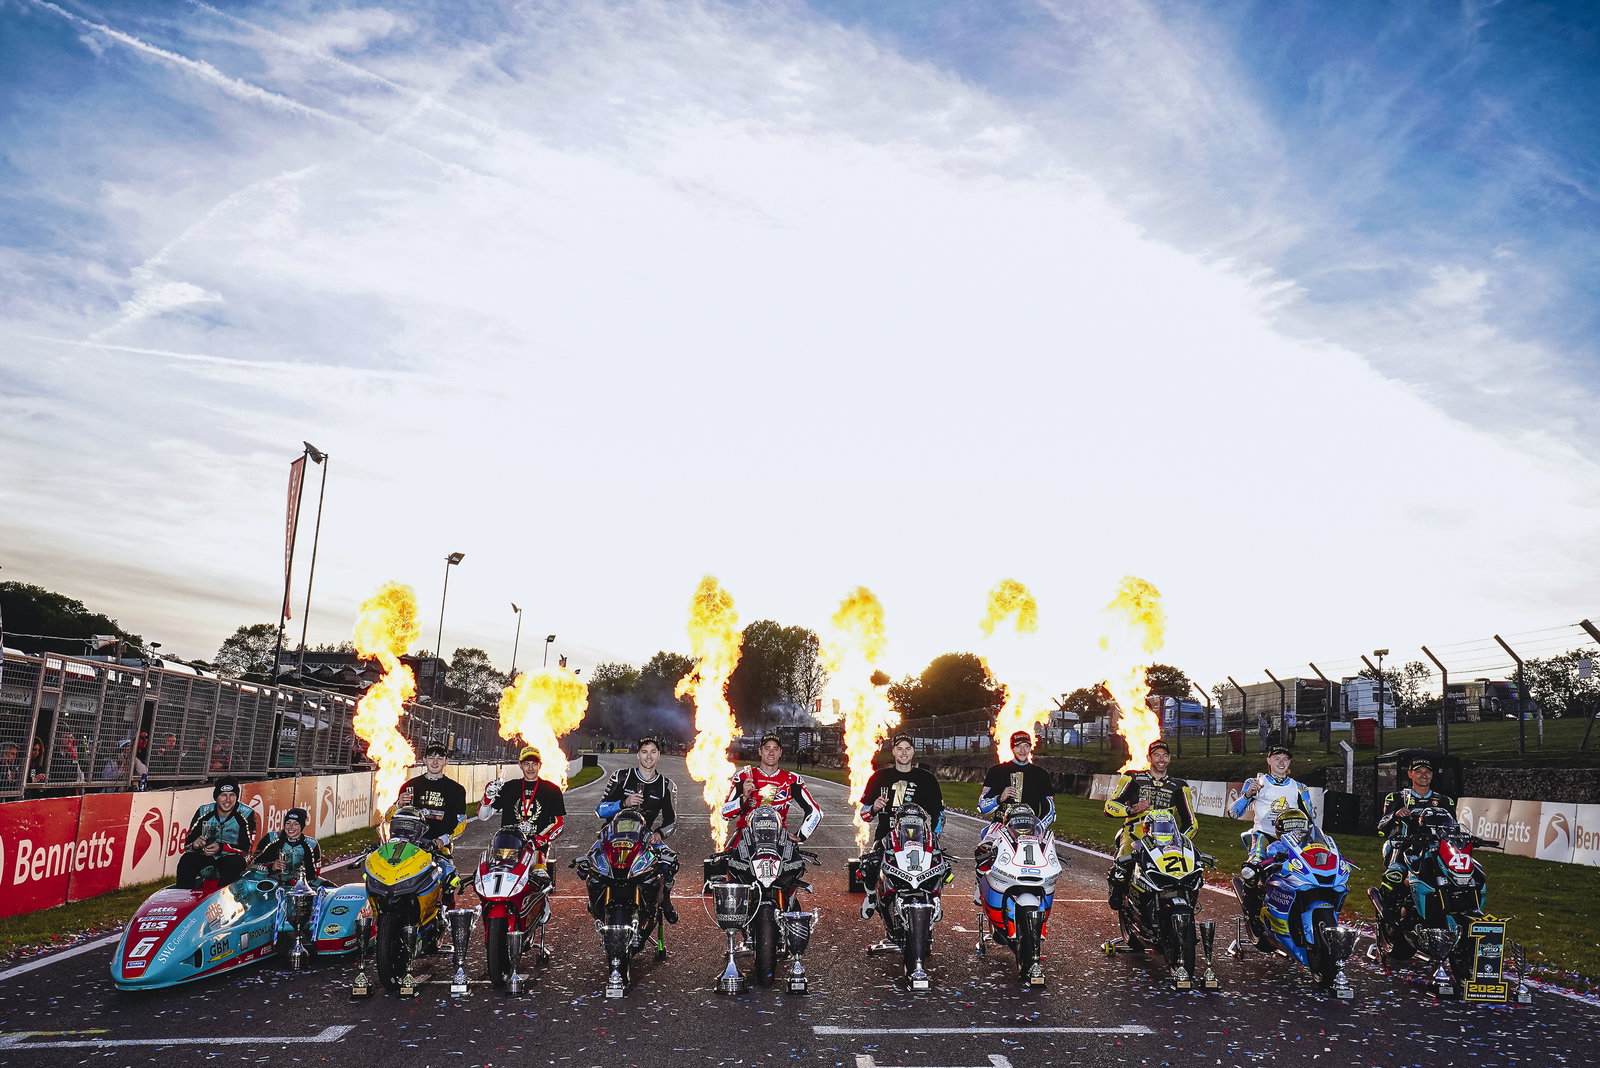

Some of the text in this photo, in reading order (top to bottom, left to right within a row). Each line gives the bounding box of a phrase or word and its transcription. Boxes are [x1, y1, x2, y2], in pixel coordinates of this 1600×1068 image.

[336, 793, 368, 819] Bennetts
[1476, 816, 1531, 843] Bennetts
[14, 831, 115, 886] Bennetts
[388, 842, 408, 865] 1
[906, 850, 922, 871] 1
[1023, 845, 1036, 865] 1
[1314, 852, 1328, 866] 1
[1449, 853, 1471, 870] 47
[889, 866, 913, 882] OXFORD
[1163, 856, 1188, 873] 21
[493, 873, 504, 895] 1
[128, 936, 160, 958] 6
[158, 942, 176, 964] SWC
[209, 938, 230, 957] GBM
[1469, 984, 1505, 994] 2023
